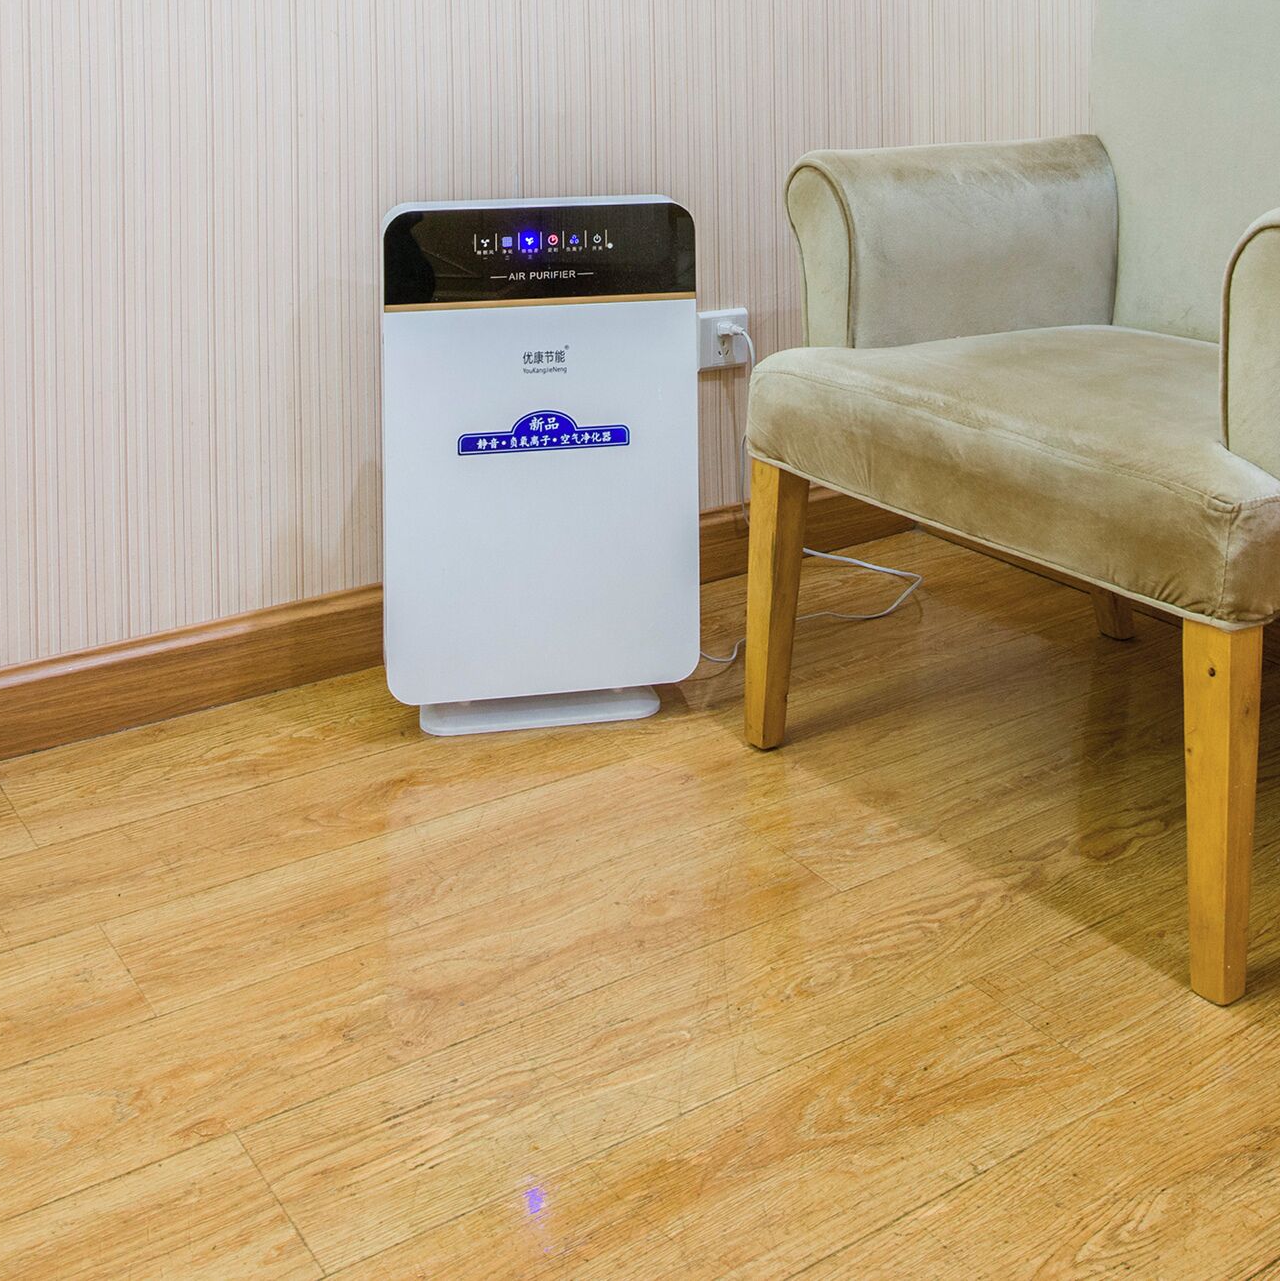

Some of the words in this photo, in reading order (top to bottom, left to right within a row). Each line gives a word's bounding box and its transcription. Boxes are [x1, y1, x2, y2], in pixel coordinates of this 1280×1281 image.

[508, 272, 526, 281] AIR
[529, 270, 576, 280] PURIFIER
[522, 349, 566, 365] 优康节能
[529, 416, 560, 432] 新品
